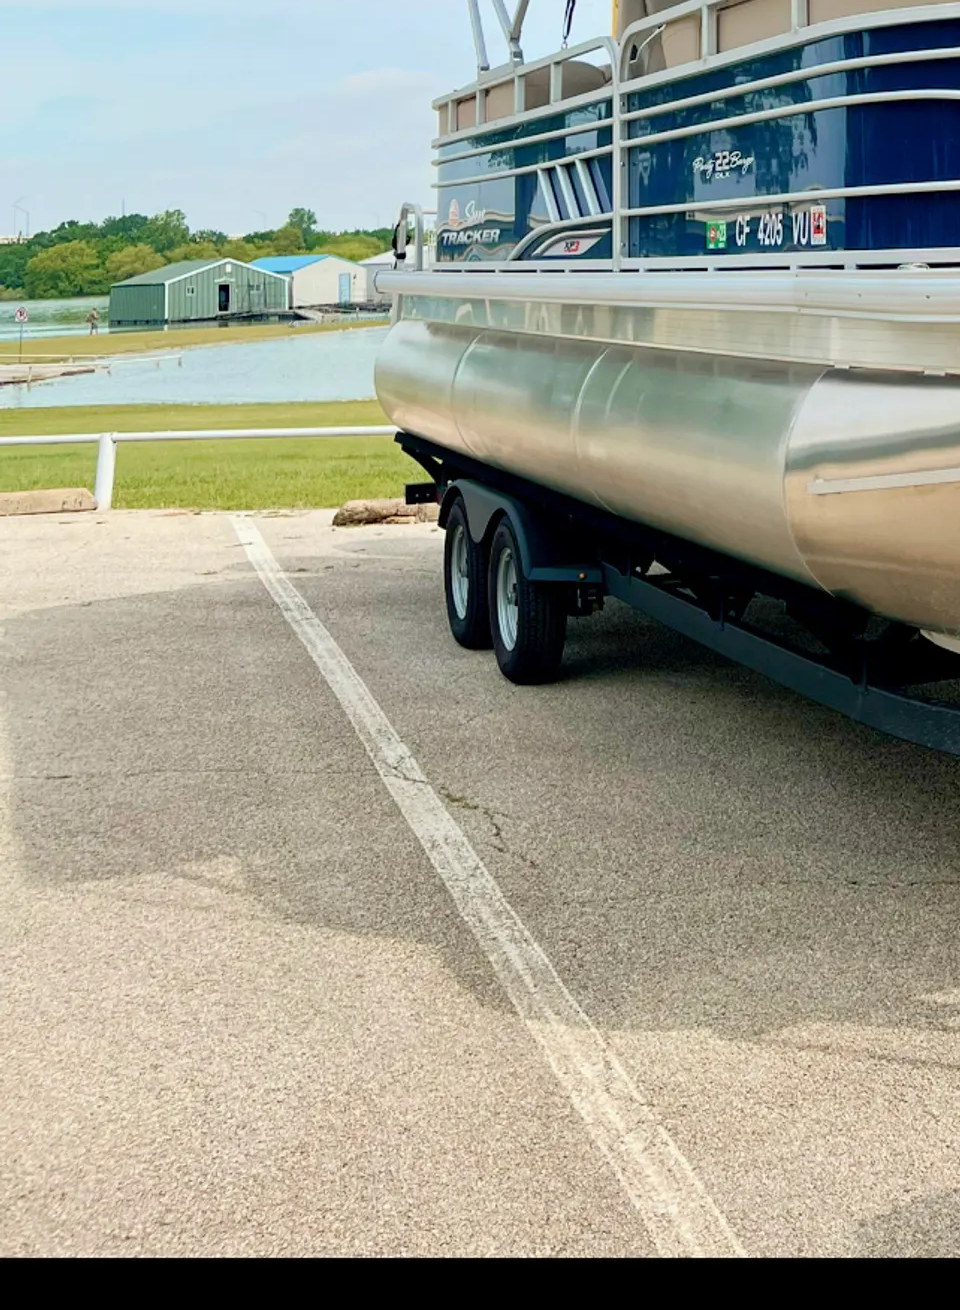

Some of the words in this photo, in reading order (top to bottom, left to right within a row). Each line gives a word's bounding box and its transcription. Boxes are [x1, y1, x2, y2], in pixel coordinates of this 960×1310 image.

[442, 229, 500, 246] TRACKER
[735, 215, 750, 246] CF
[758, 213, 783, 246] 4205
